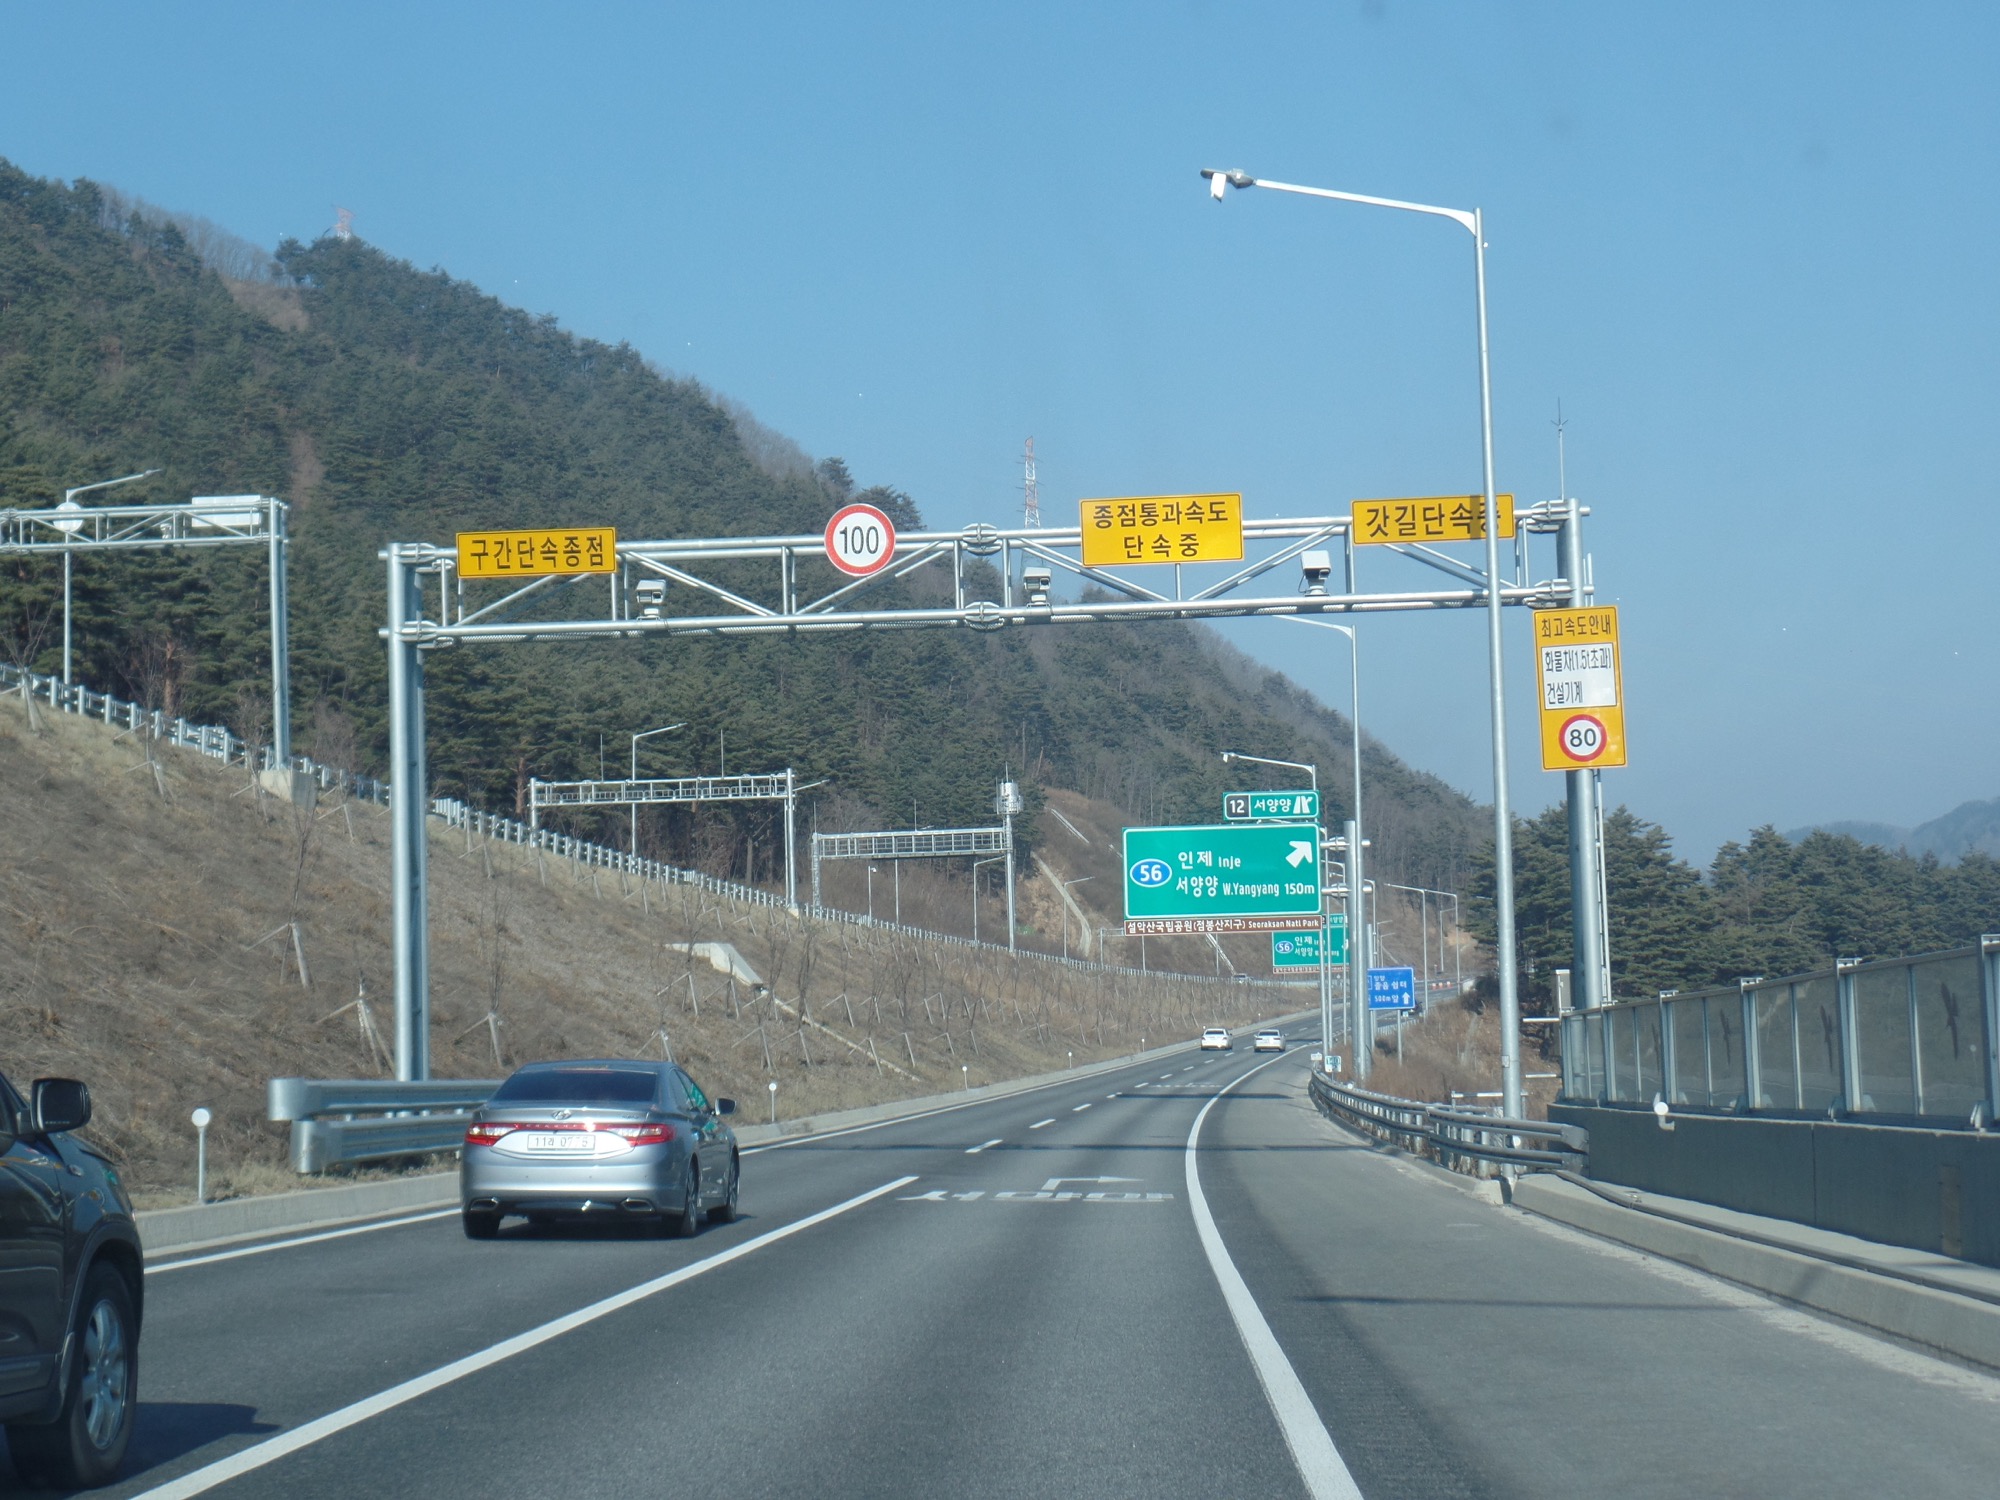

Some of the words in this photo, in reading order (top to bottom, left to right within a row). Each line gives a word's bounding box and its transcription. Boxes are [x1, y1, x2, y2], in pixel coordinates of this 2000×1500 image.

[1093, 500, 1229, 529] 종점통과속도
[470, 533, 604, 570] 구간단속종점
[839, 525, 879, 555] 100
[1124, 533, 1200, 559] 단속중
[1541, 614, 1612, 638] 최고속도안내
[1547, 681, 1583, 705] 건설기계
[1569, 728, 1597, 748] 80
[1230, 800, 1245, 813] 12
[1254, 798, 1292, 813] 서양양
[1178, 850, 1213, 869] 인제
[1218, 856, 1241, 870] Inje
[1139, 864, 1162, 882] 56
[1176, 875, 1219, 898] 서양양
[1223, 882, 1280, 898] W.Yangyang
[1285, 882, 1315, 896] 150m
[1302, 918, 1319, 928] Park
[1278, 943, 1290, 952] 56
